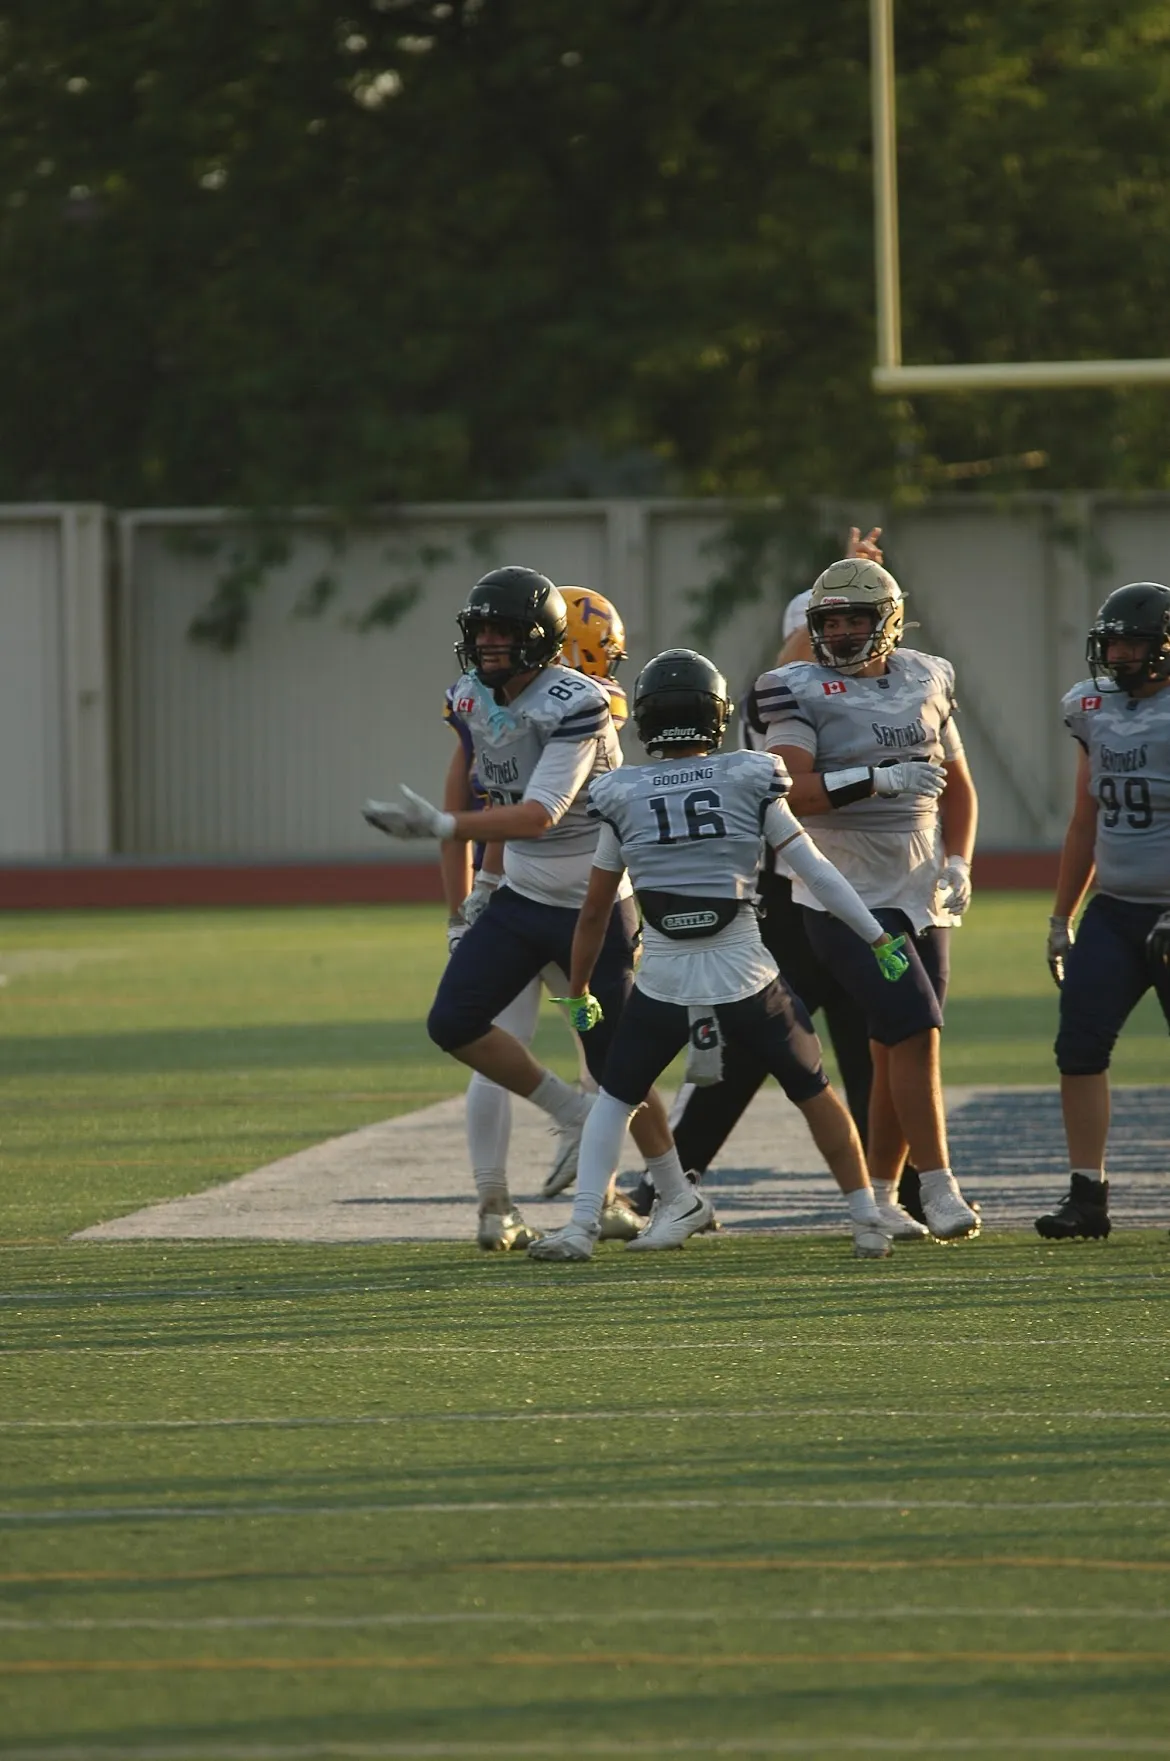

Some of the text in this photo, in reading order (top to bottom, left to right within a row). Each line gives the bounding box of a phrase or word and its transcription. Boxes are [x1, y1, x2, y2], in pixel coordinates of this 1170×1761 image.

[548, 677, 586, 701] 85
[653, 767, 714, 786] GOODING
[1099, 777, 1153, 829] 99
[648, 788, 727, 844] 16
[666, 914, 713, 927] BATTLE
